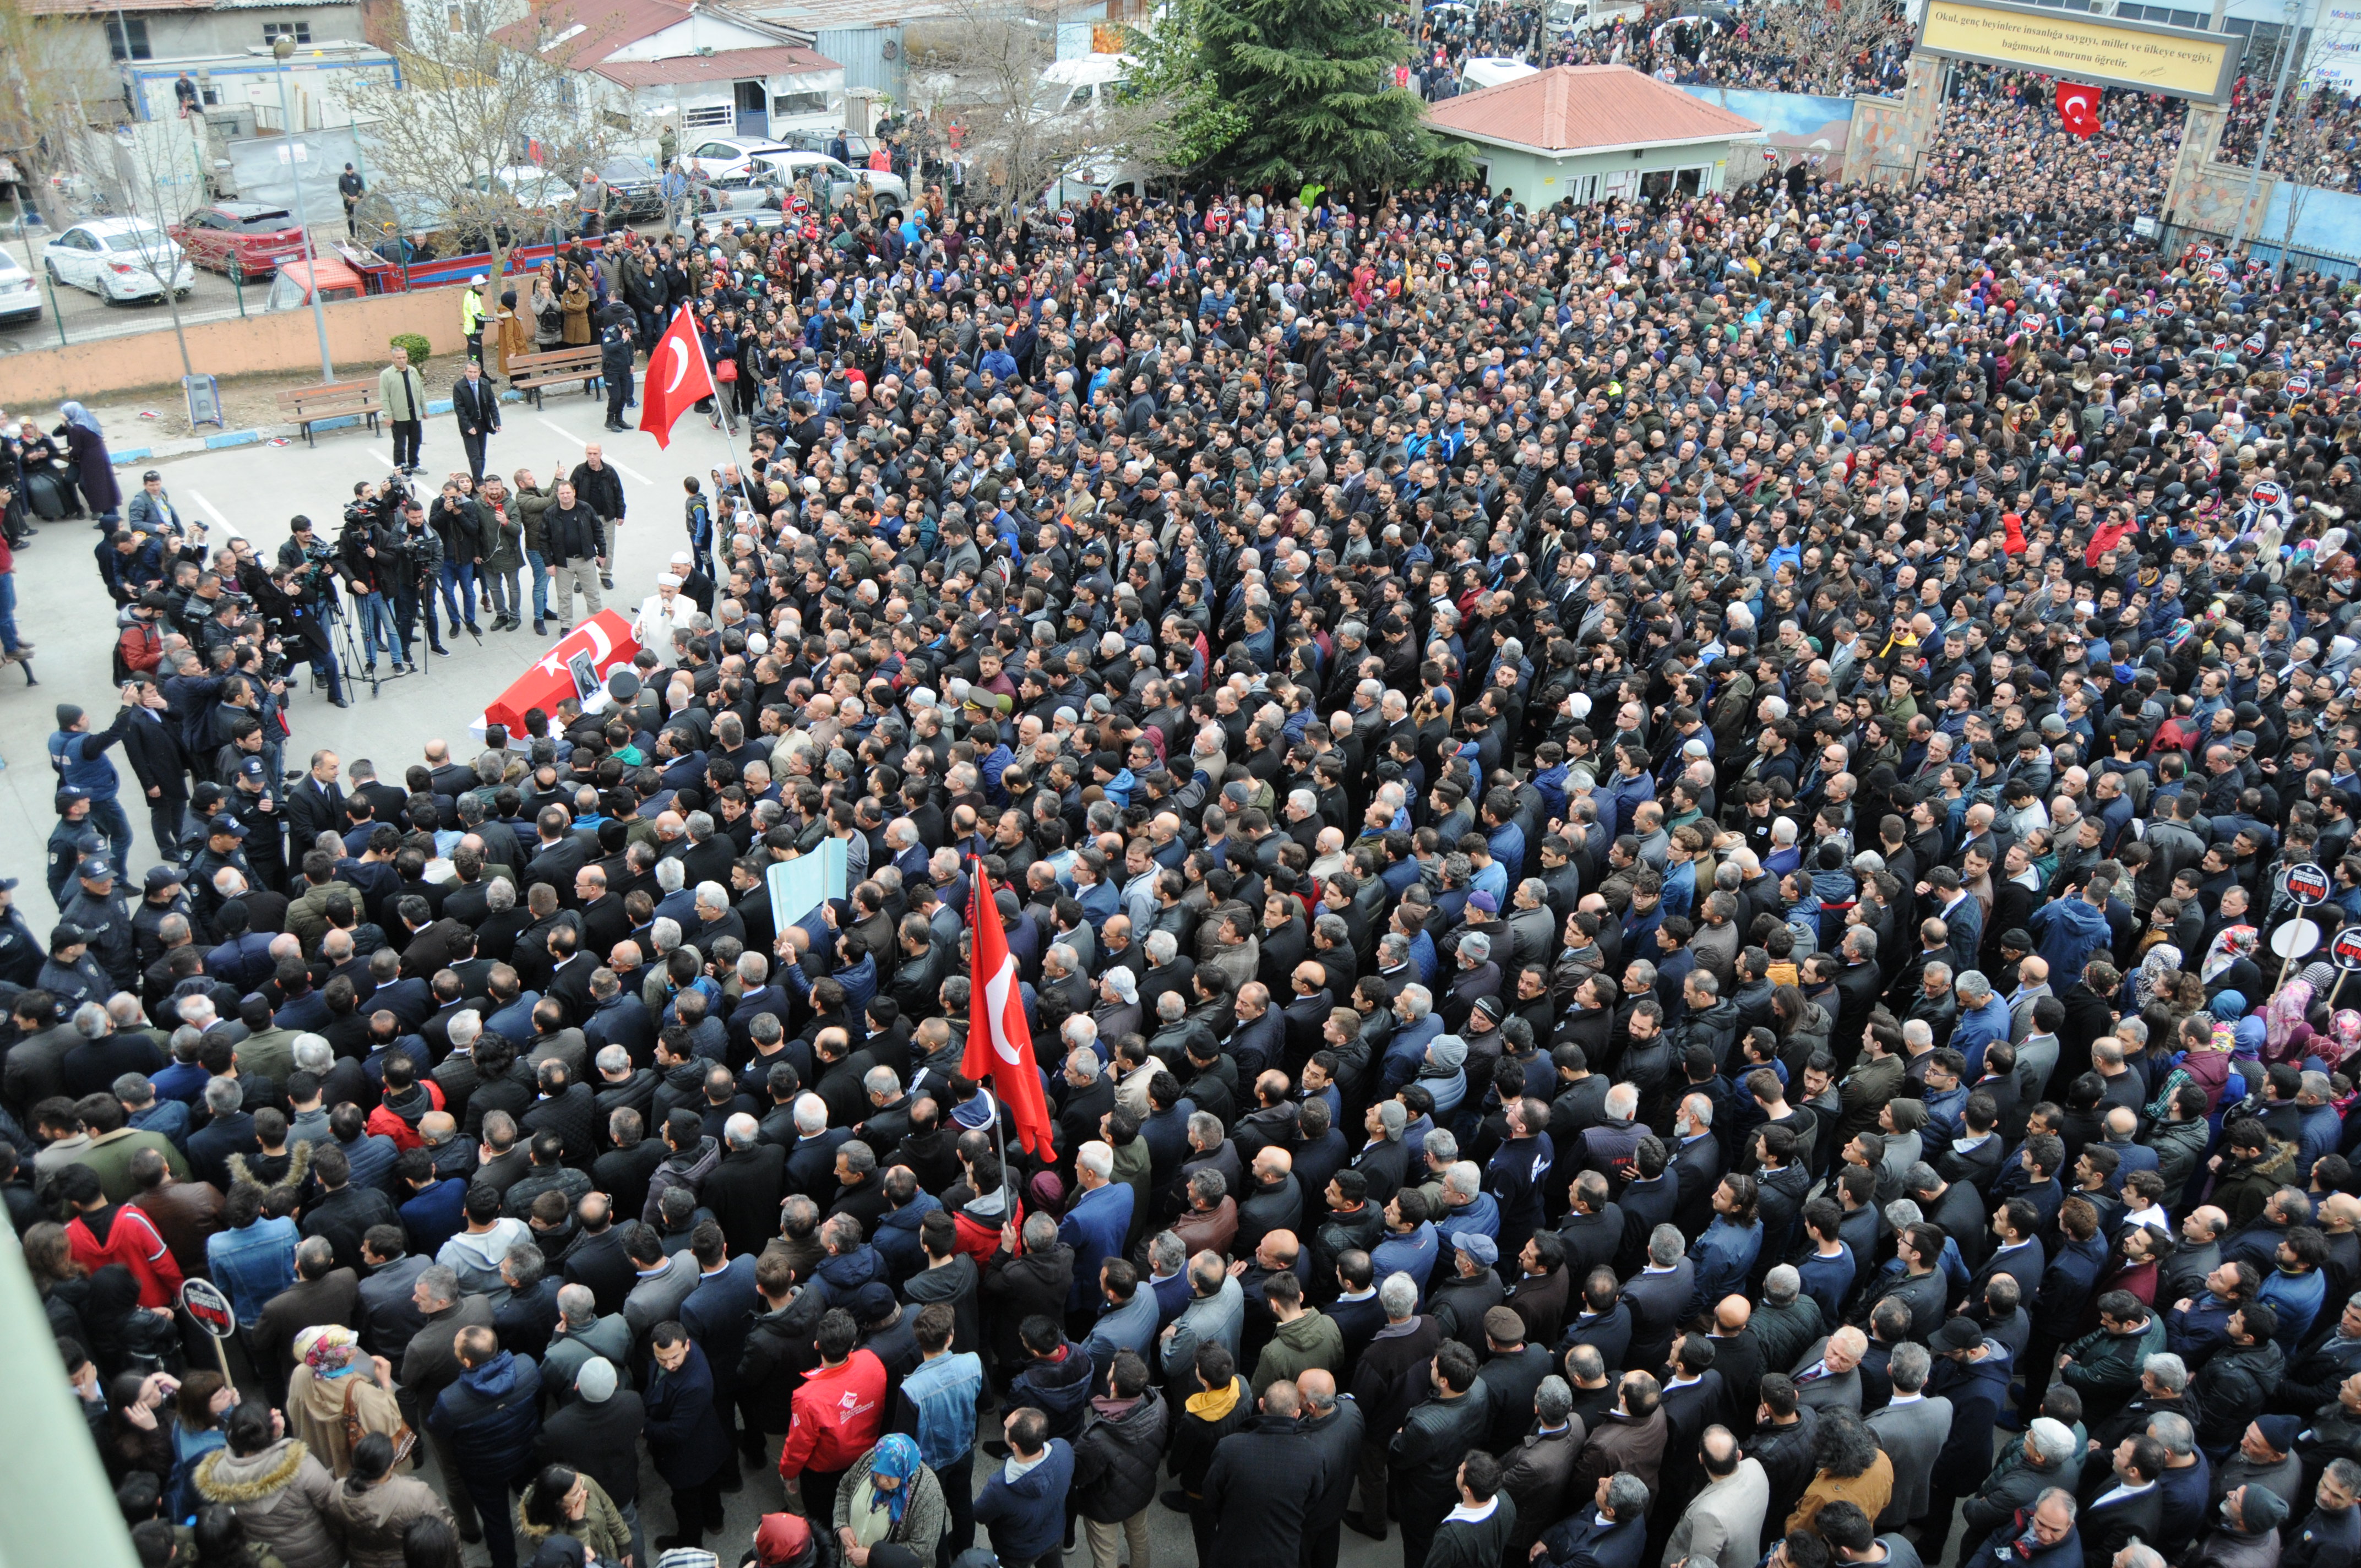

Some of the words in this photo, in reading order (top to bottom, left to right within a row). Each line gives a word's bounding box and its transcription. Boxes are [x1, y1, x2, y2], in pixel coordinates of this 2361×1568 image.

[2331, 10, 2355, 19] Mobil
[1935, 12, 1958, 23] Okul,
[1961, 18, 1980, 27] genç
[1982, 19, 2021, 33] beyinlere
[2023, 25, 2063, 40] insanlığa
[2065, 34, 2098, 45] saygıyı,
[2102, 37, 2128, 50] millet
[2144, 44, 2174, 58] ülkeye
[2178, 51, 2213, 64] sevgiyi,
[2327, 42, 2351, 51] Mobil
[2002, 39, 2051, 55] bağımsızlık
[2054, 50, 2092, 62] onurunu
[2095, 55, 2128, 68] öğretir.
[2316, 68, 2341, 78] Mobil
[2292, 874, 2322, 887] ŞİDDETE
[2293, 869, 2324, 881] EĞİTİMCİYE
[2289, 879, 2325, 899] HAYIR!
